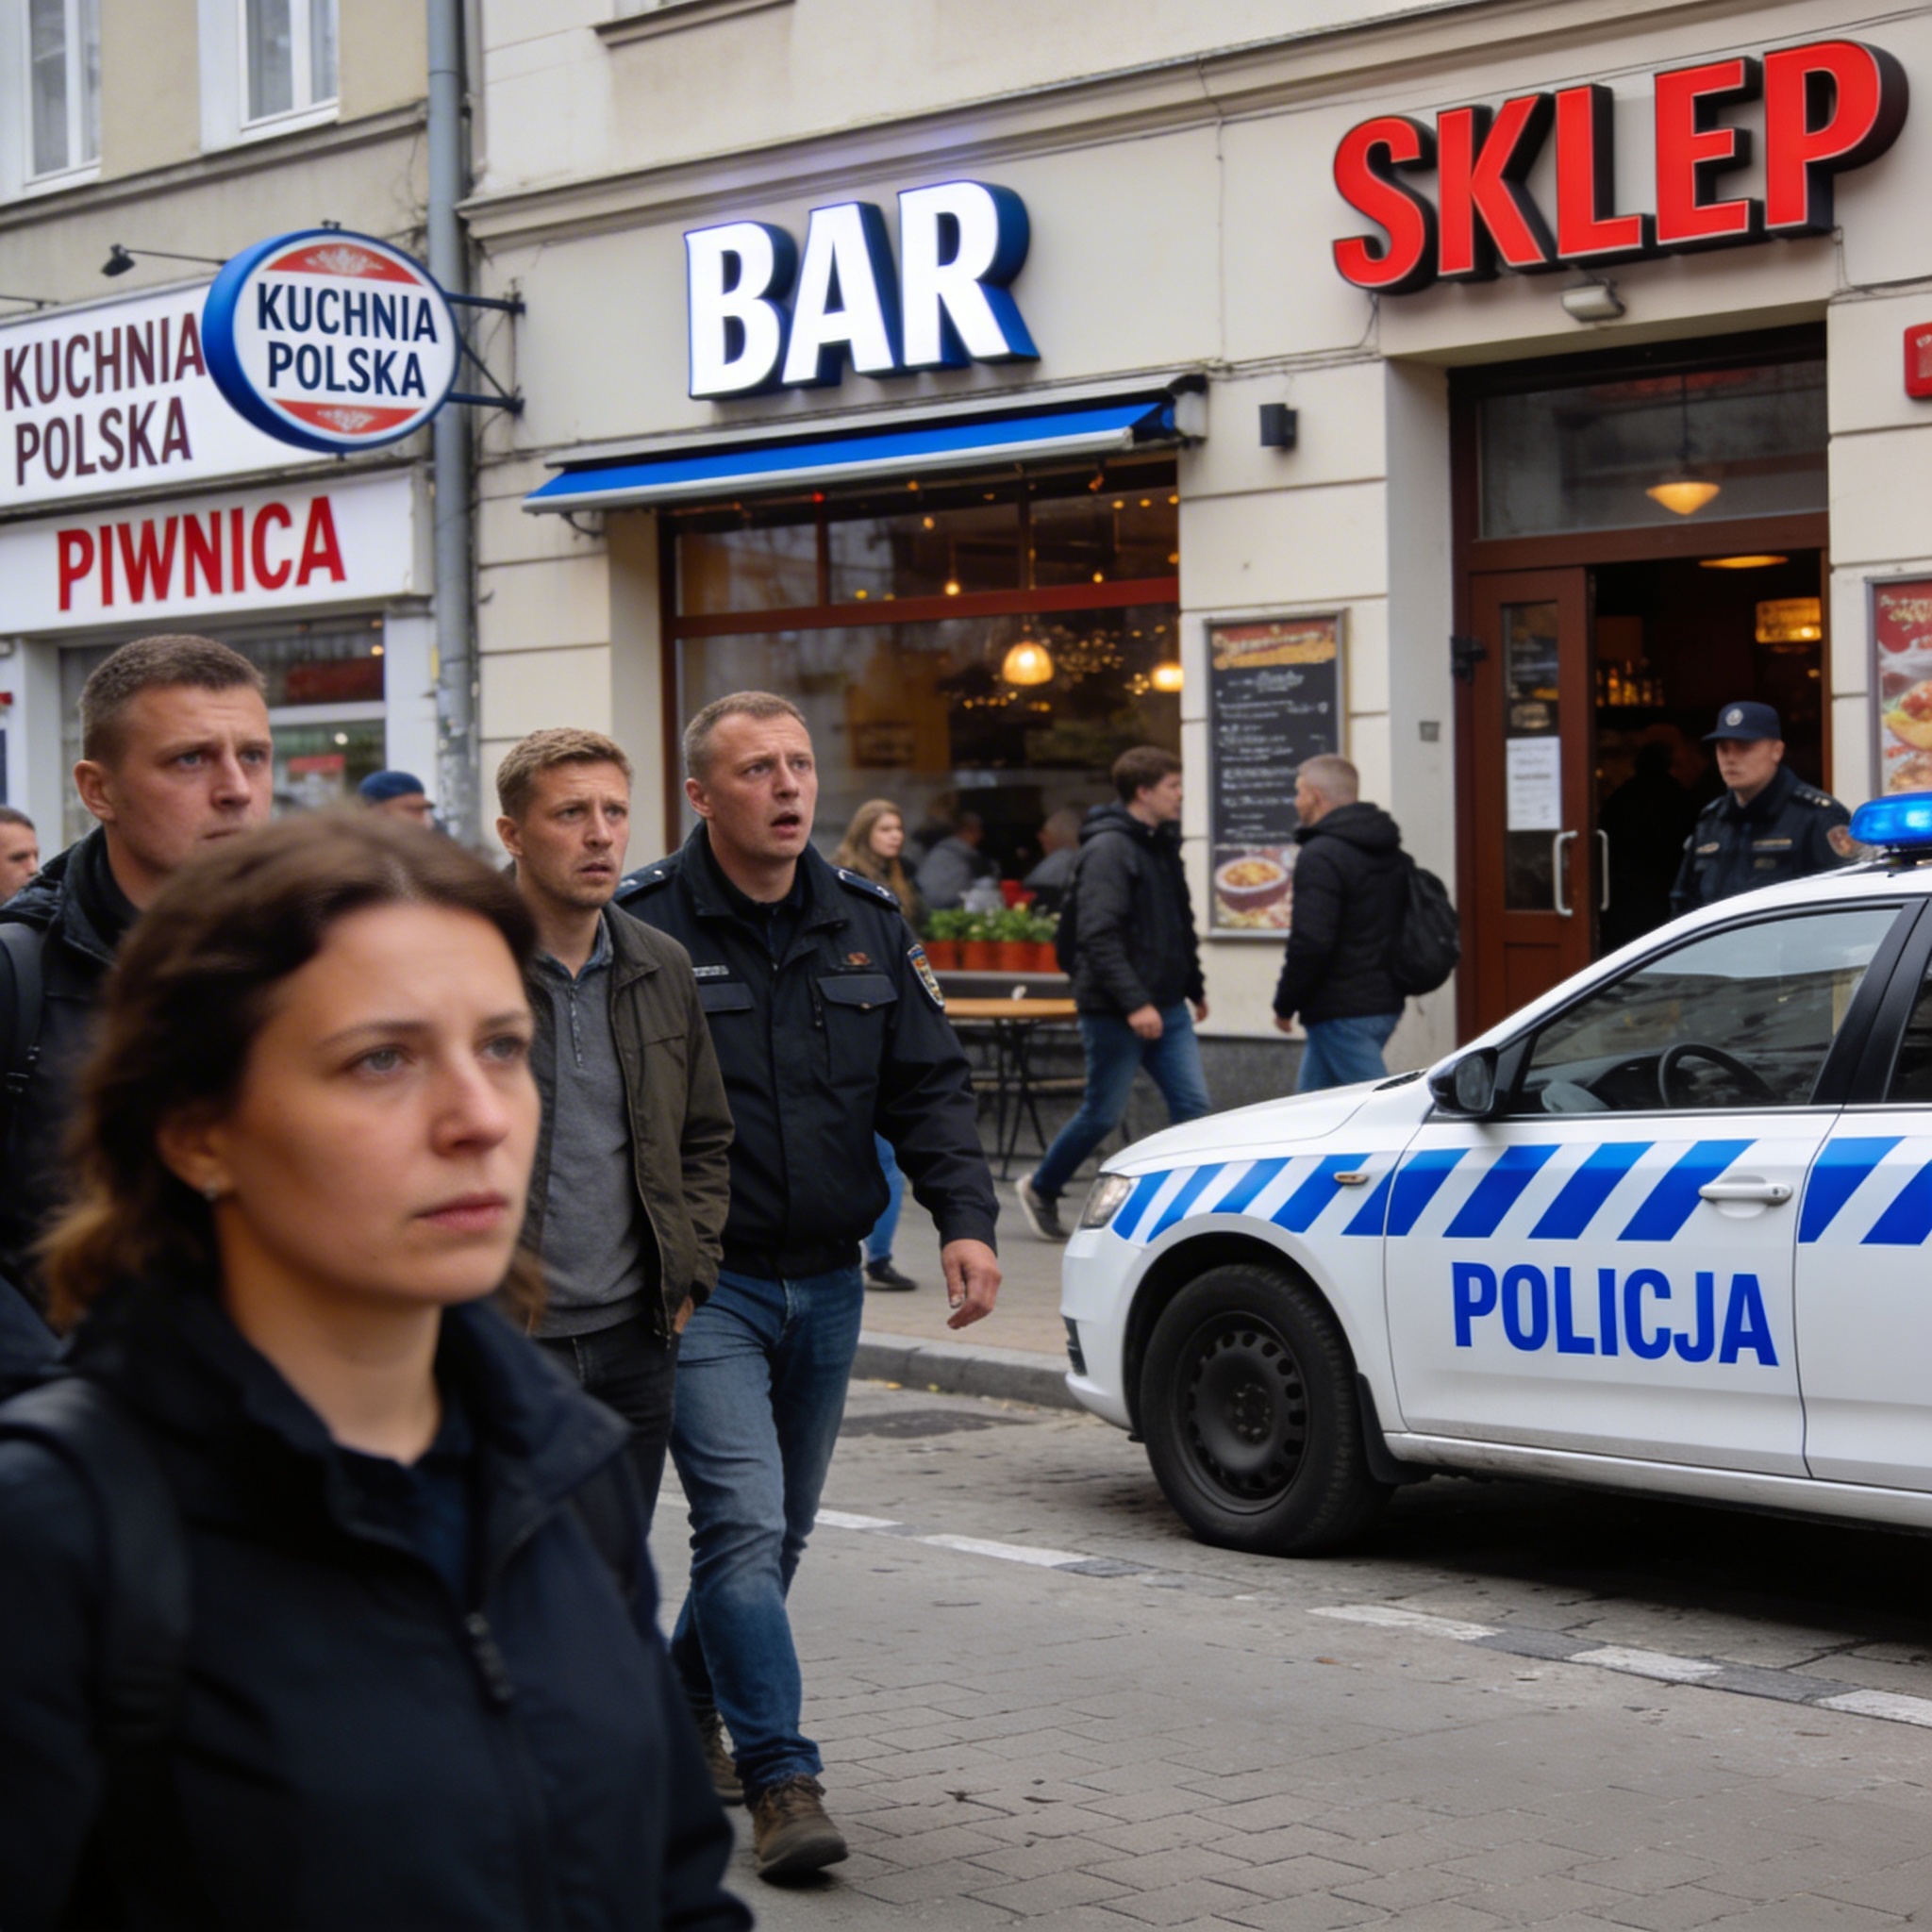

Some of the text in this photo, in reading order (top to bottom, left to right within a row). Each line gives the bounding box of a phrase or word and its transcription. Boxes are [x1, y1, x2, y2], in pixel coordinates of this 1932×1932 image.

[1332, 40, 1907, 293] SKLEP
[258, 282, 439, 343] KUCHNIA
[684, 179, 1038, 398] BAR
[4, 312, 207, 410] KUCHNIA
[268, 341, 426, 398] POLSKA
[15, 396, 192, 486] POLSKA
[57, 495, 346, 612] PIWNICA
[1452, 1262, 1779, 1367] POLICJA
